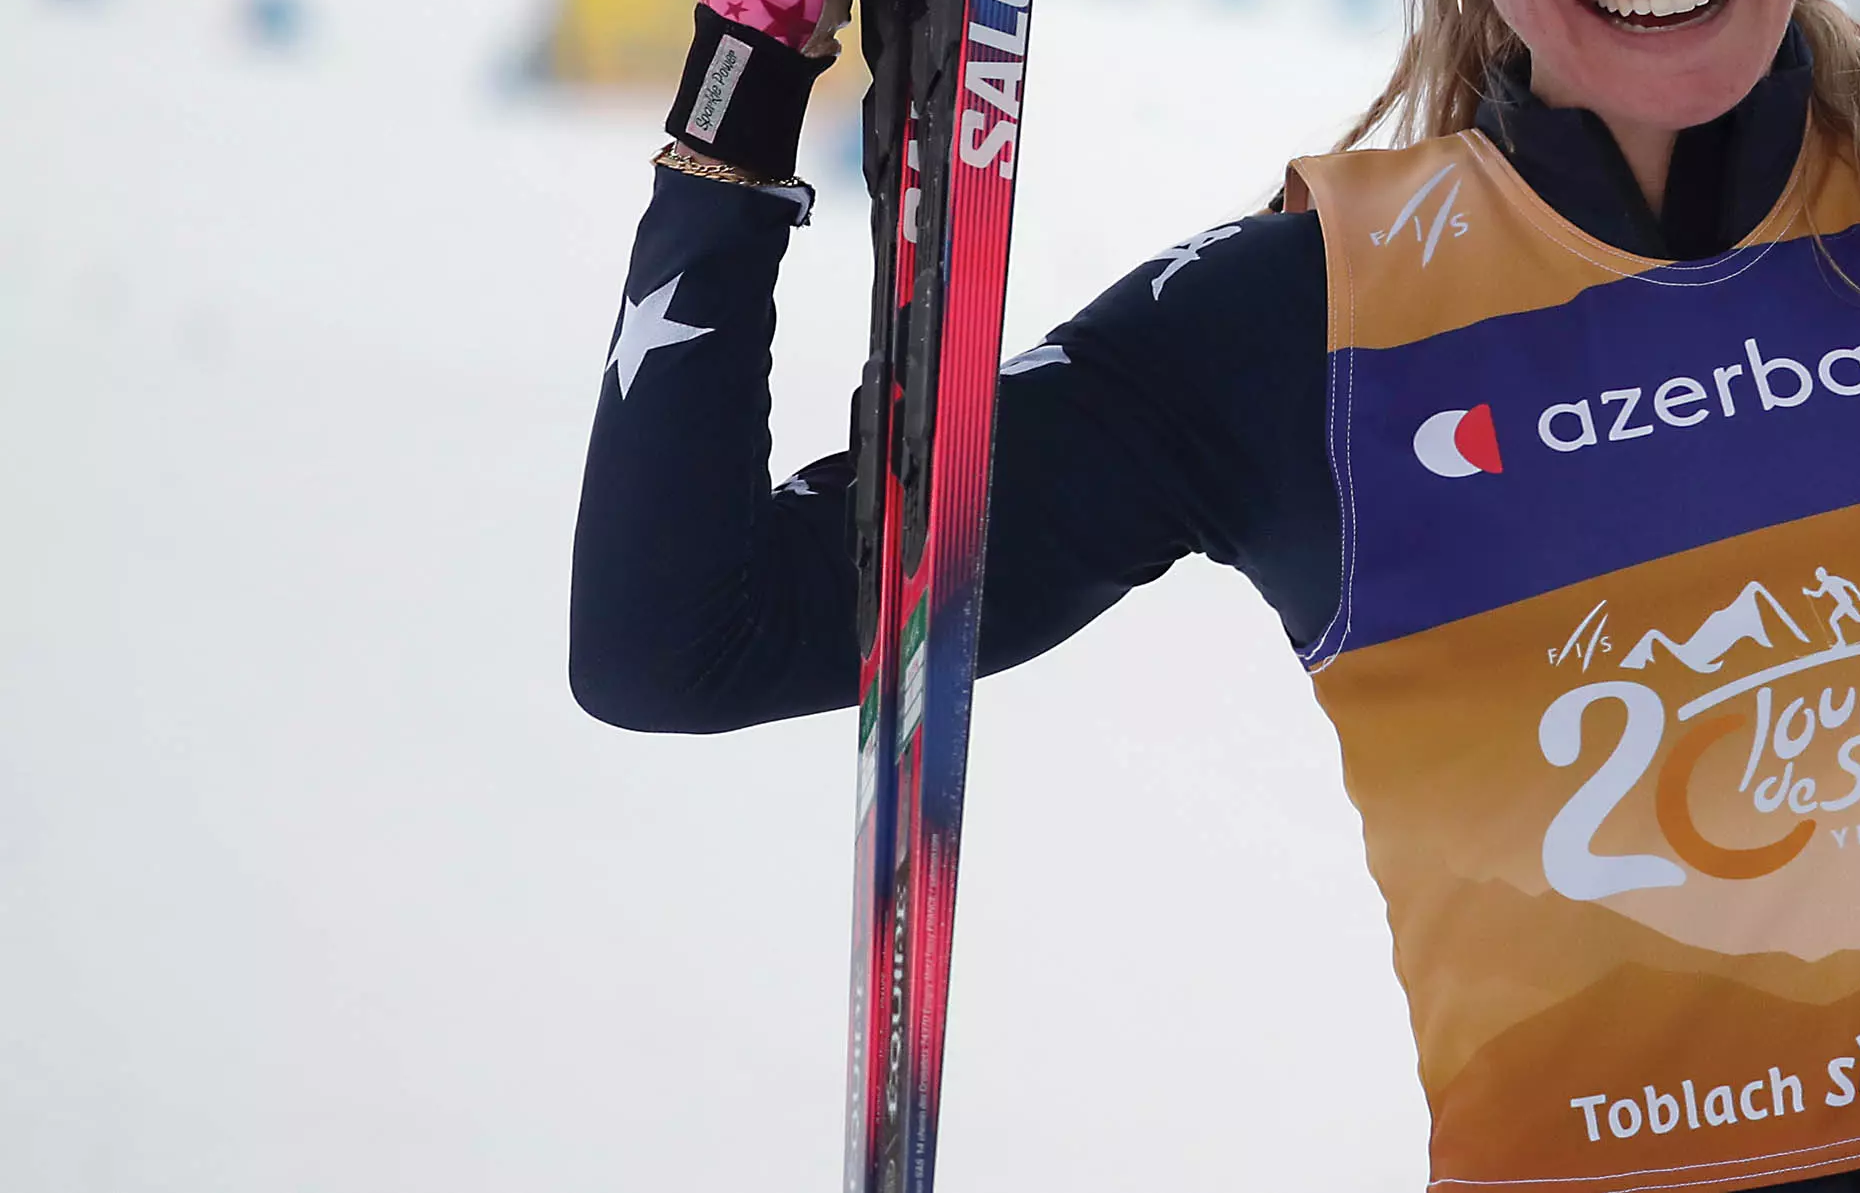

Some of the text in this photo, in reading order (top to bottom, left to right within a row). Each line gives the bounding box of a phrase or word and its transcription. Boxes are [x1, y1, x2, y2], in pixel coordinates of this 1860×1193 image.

[695, 49, 737, 131] Sparkle Power
[1754, 762, 1817, 815] de
[1570, 1066, 1805, 1142] Toblach
